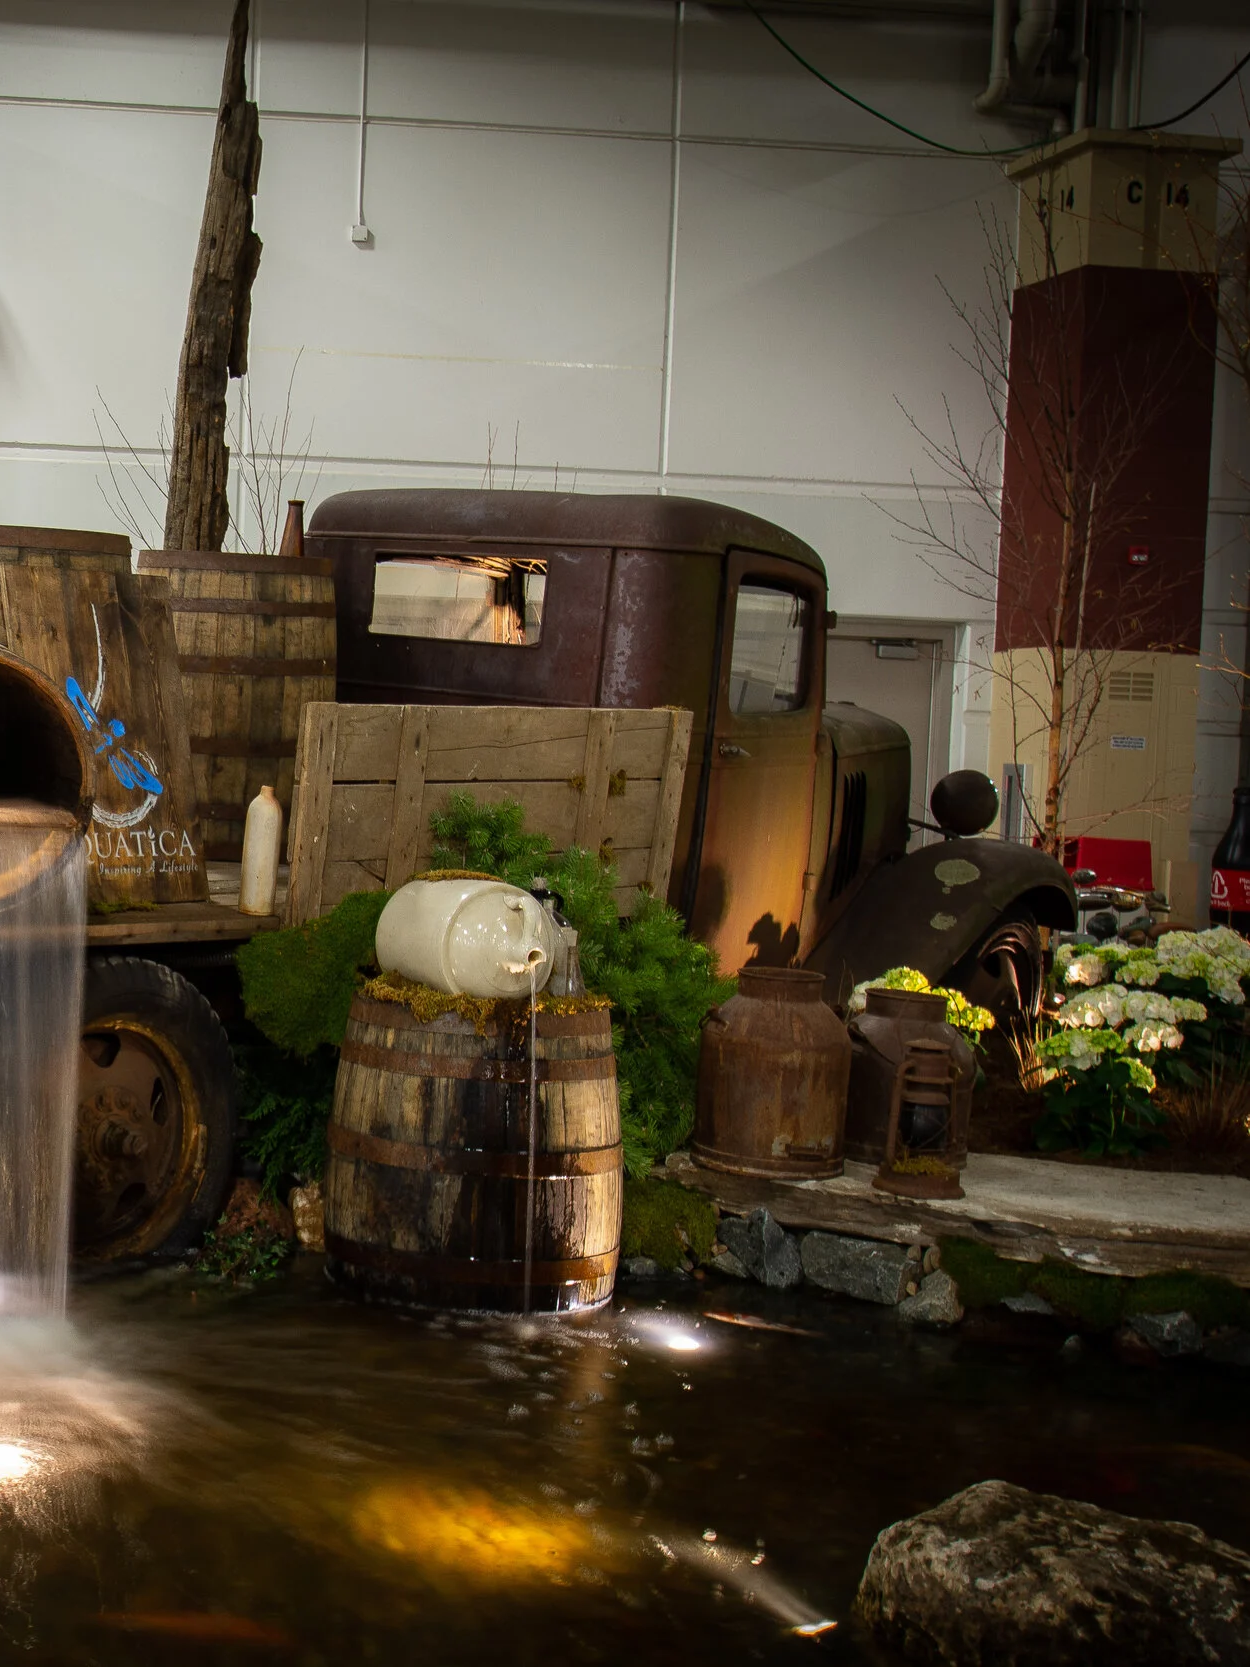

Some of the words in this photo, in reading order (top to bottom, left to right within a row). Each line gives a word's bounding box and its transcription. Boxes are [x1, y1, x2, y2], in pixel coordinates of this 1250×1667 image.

[1127, 180, 1143, 204] C
[99, 862, 142, 876] Inspiring
[159, 859, 199, 874] Lifestyle
